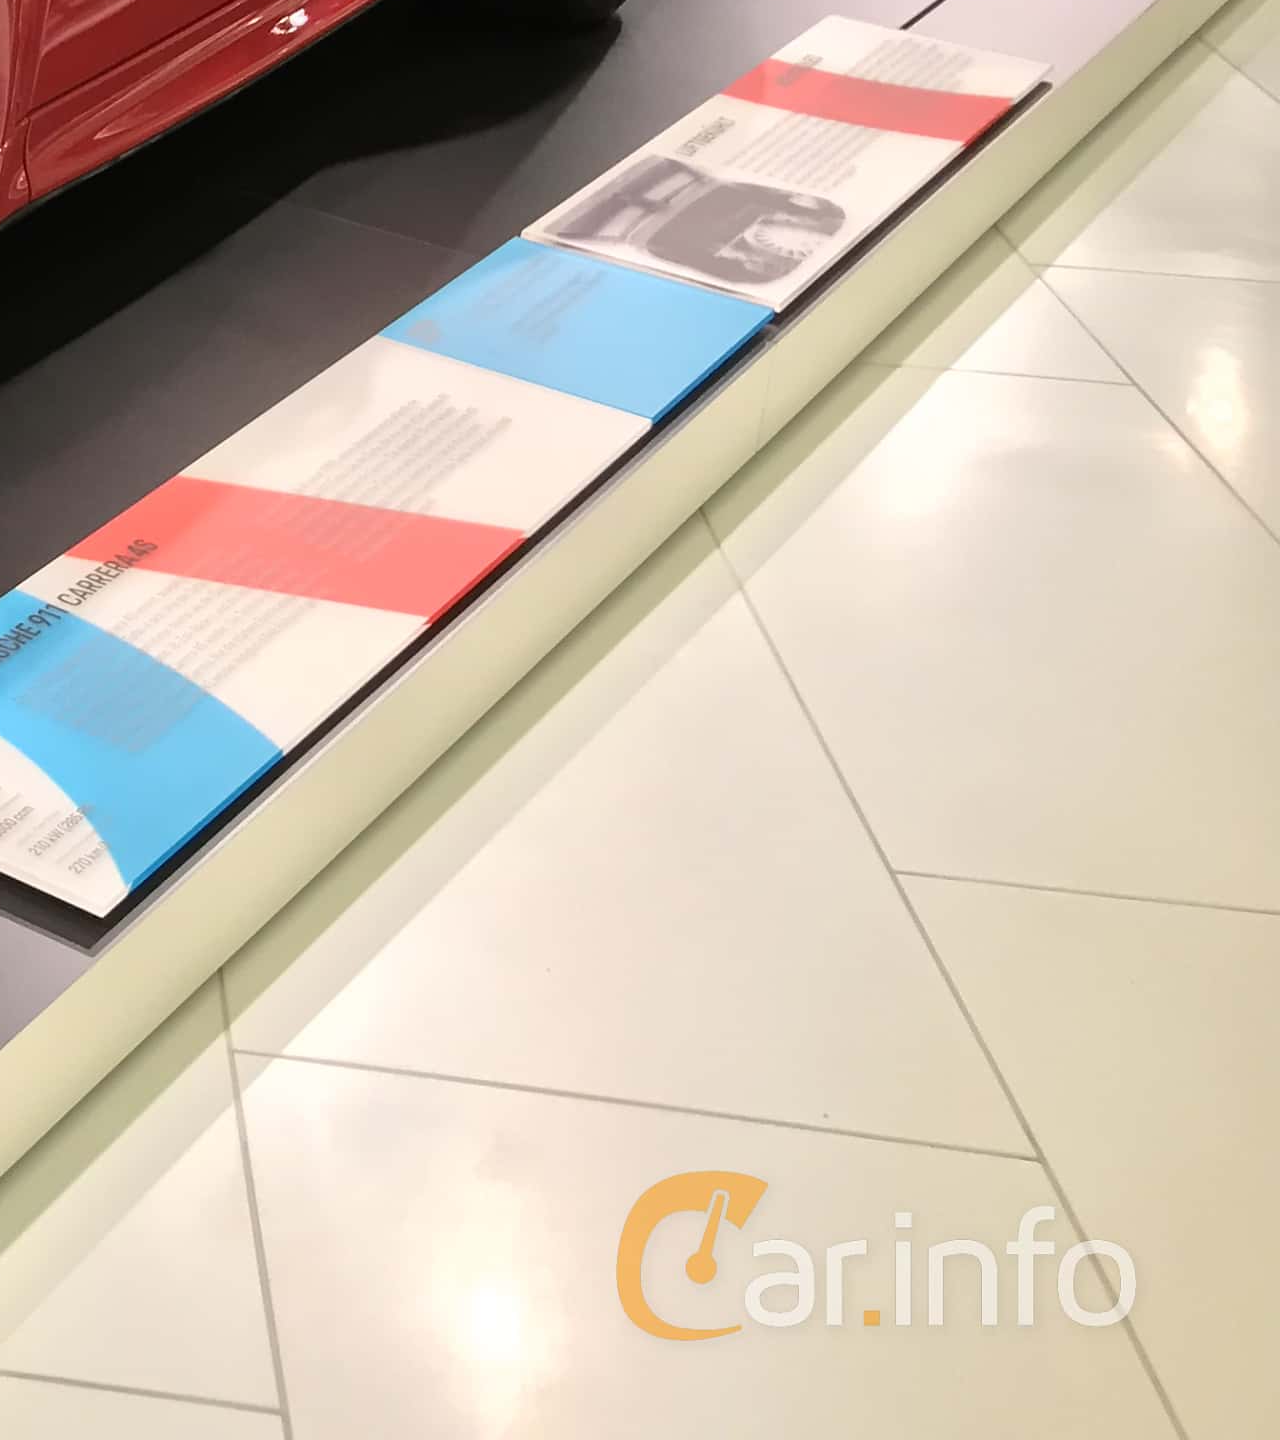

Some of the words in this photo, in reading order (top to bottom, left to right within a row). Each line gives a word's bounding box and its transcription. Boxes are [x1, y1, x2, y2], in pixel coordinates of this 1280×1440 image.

[31, 603, 70, 628] 911
[58, 552, 136, 607] CARRERA
[127, 539, 159, 566] 4S
